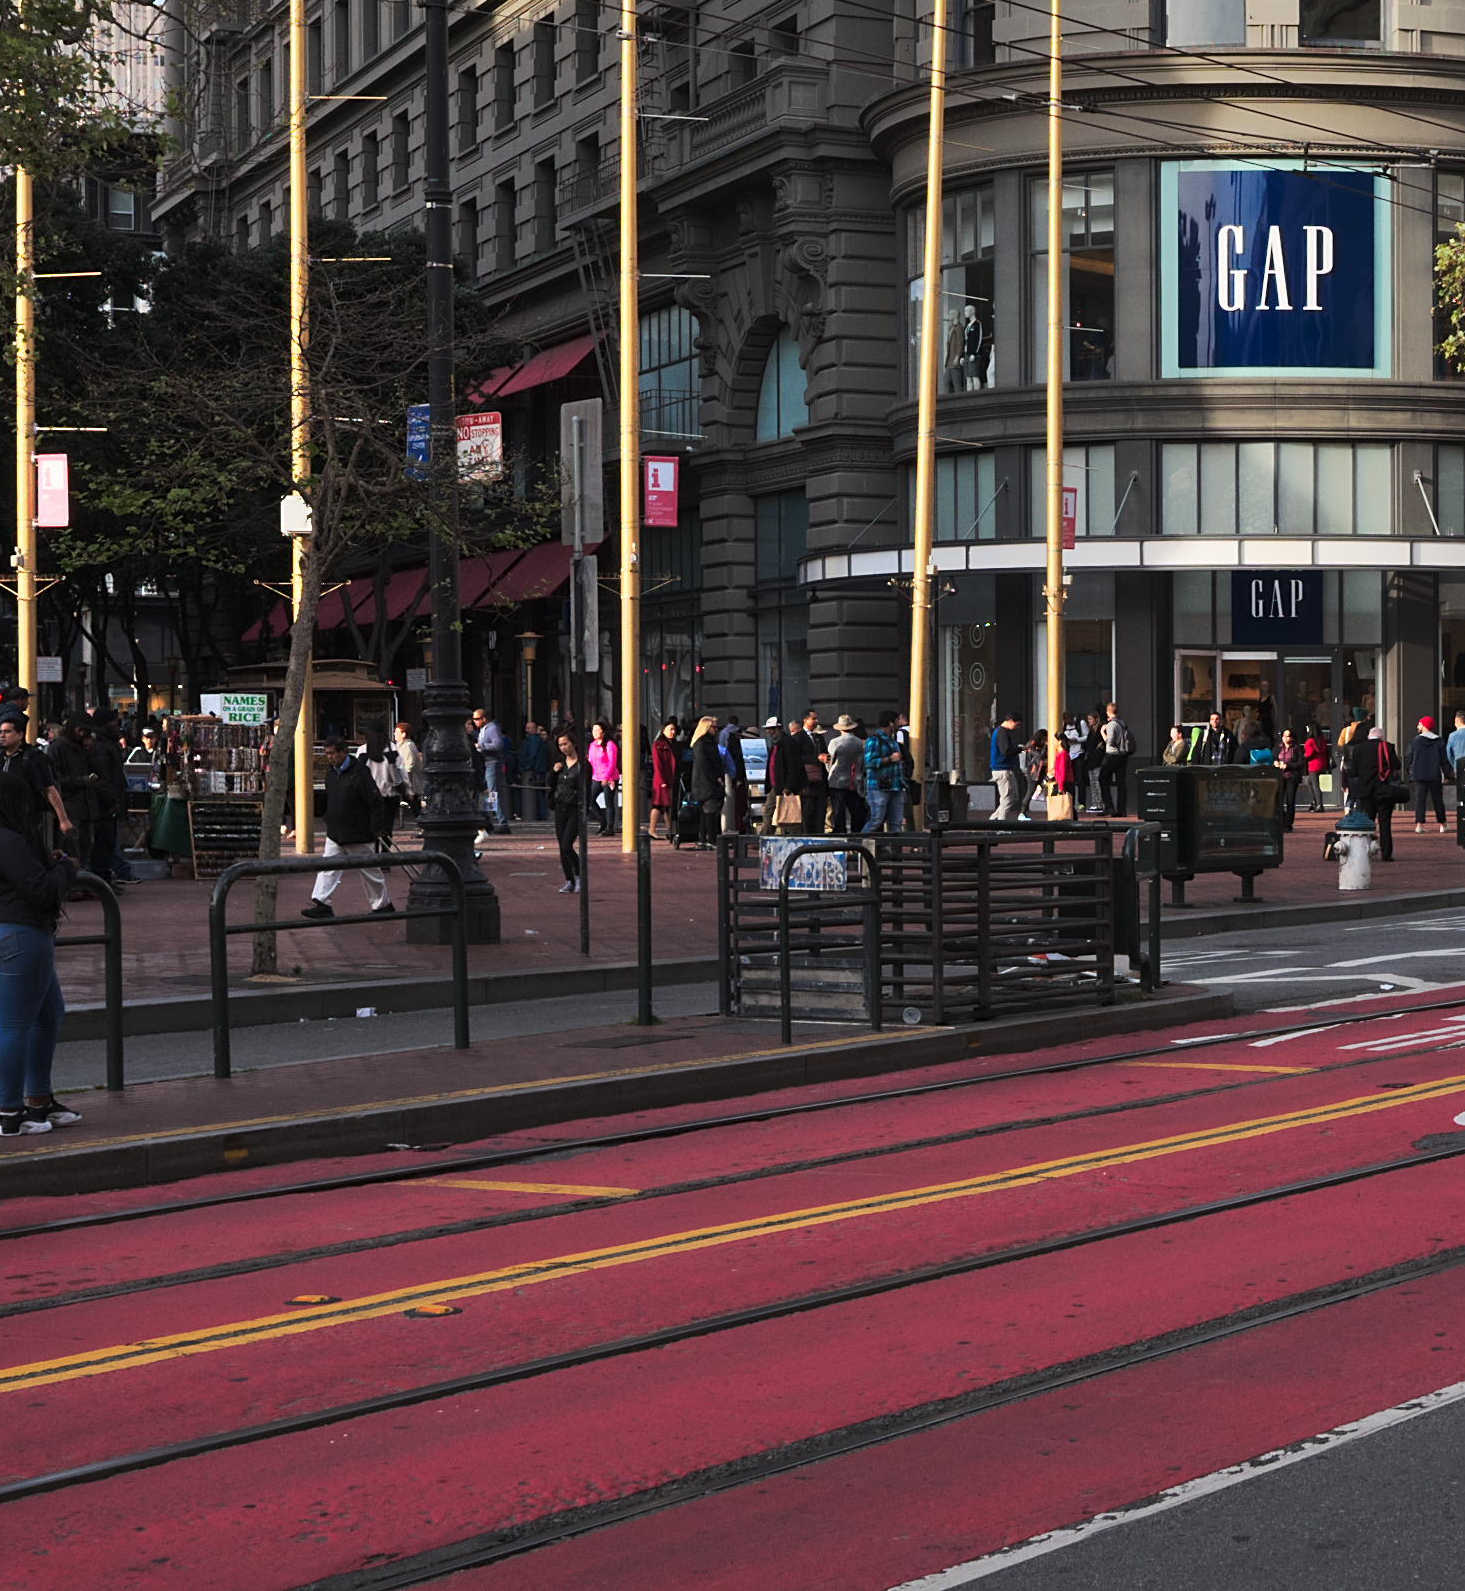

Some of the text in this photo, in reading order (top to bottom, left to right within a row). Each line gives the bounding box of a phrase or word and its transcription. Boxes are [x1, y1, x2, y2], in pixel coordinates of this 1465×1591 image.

[1218, 225, 1334, 311] GAP
[456, 426, 469, 440] NO
[1251, 579, 1303, 618] GAP
[223, 696, 266, 705] NAMES
[228, 713, 261, 722] RICE
